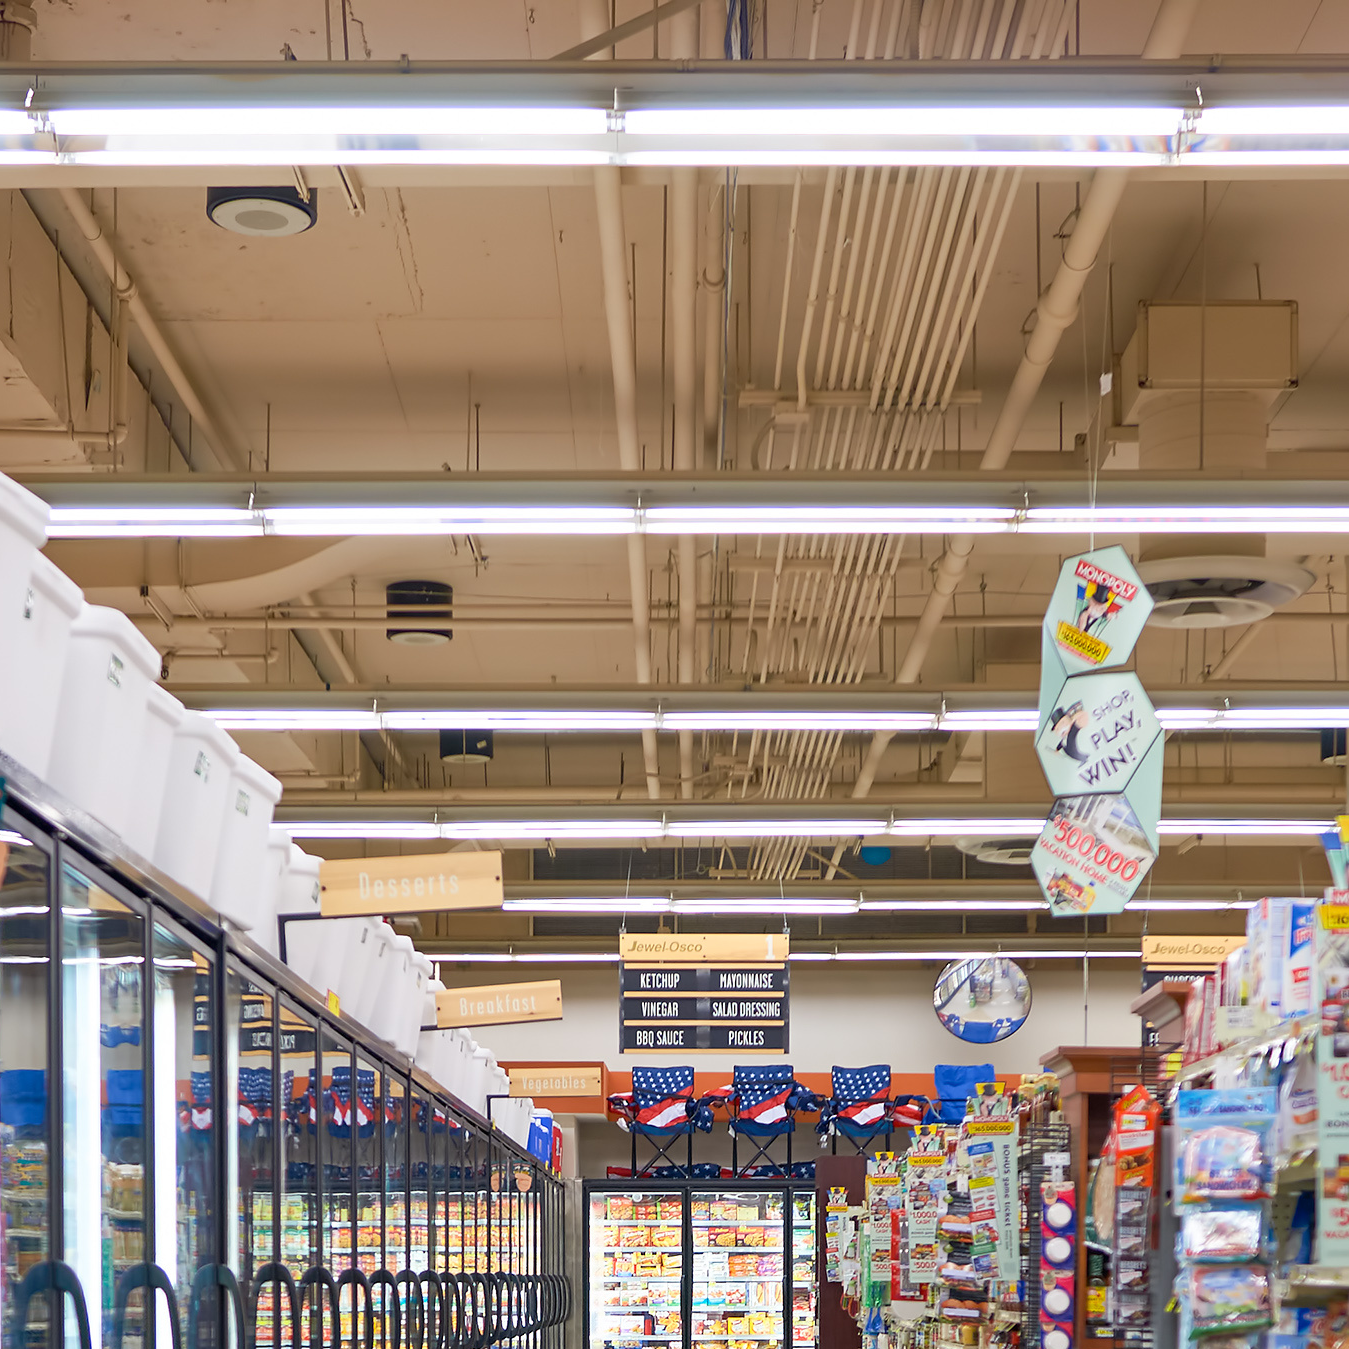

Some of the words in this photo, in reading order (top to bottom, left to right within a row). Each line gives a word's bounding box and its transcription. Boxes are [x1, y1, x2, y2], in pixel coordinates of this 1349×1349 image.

[1076, 562, 1136, 598] MONOPOLY
[1092, 689, 1134, 721] SHOP,
[1091, 709, 1141, 750] PLAY,
[1079, 742, 1137, 786] WIN!
[1039, 836, 1080, 867] VACATION
[1080, 860, 1108, 884] HOME
[359, 871, 459, 900] Desserts
[627, 940, 703, 953] Jewel-Osco
[765, 934, 776, 960] 1
[1150, 942, 1226, 955] Jewel-Osco
[640, 973, 680, 989] KETCHUP
[719, 973, 774, 989] MAYONNAISE
[459, 994, 536, 1017] Breakfast
[641, 1002, 679, 1017] VINEGAR
[712, 1002, 738, 1017] SALAD
[739, 1002, 781, 1017] DRESSING
[636, 1030, 654, 1047] BBQ
[656, 1030, 685, 1046] SAUCE
[728, 1030, 765, 1046] PICKLES
[521, 1075, 587, 1093] Vegetables
[1002, 1144, 1011, 1174] BONUS
[1002, 1177, 1010, 1199] game
[1004, 1201, 1012, 1227] ticket
